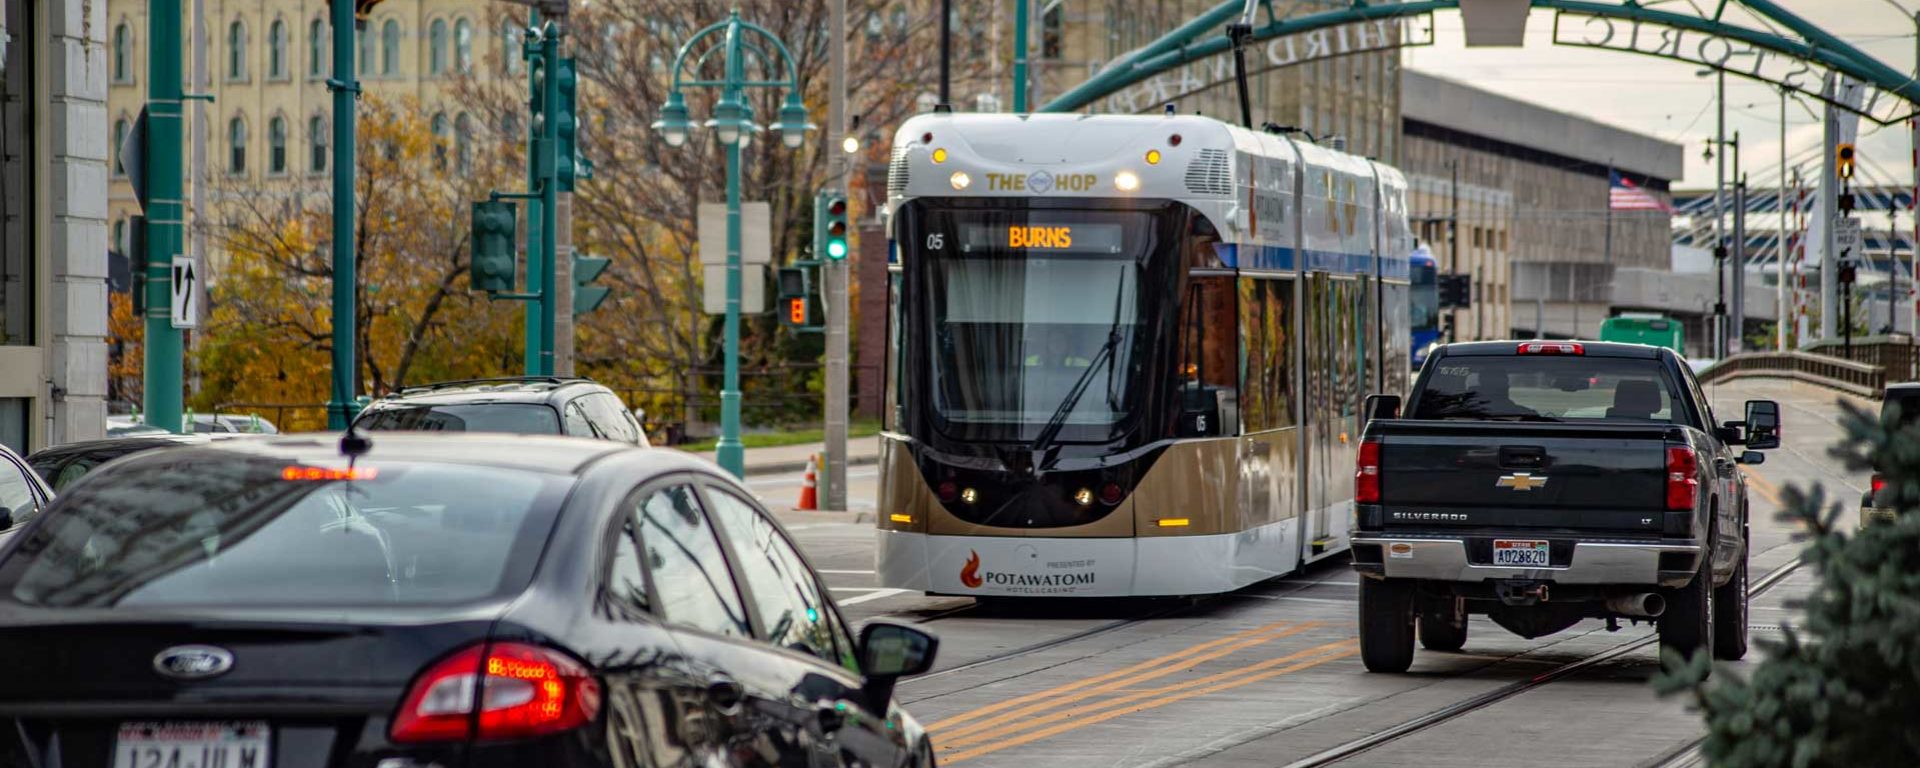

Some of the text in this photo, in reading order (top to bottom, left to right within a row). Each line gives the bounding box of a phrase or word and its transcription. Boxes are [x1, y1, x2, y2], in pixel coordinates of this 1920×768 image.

[986, 173, 1026, 191] THE
[1055, 173, 1097, 191] HOP
[927, 233, 944, 249] 05
[1008, 226, 1072, 248] BURNS
[1393, 512, 1468, 521] SILVERADO
[986, 571, 1096, 586] POTAWATOMI
